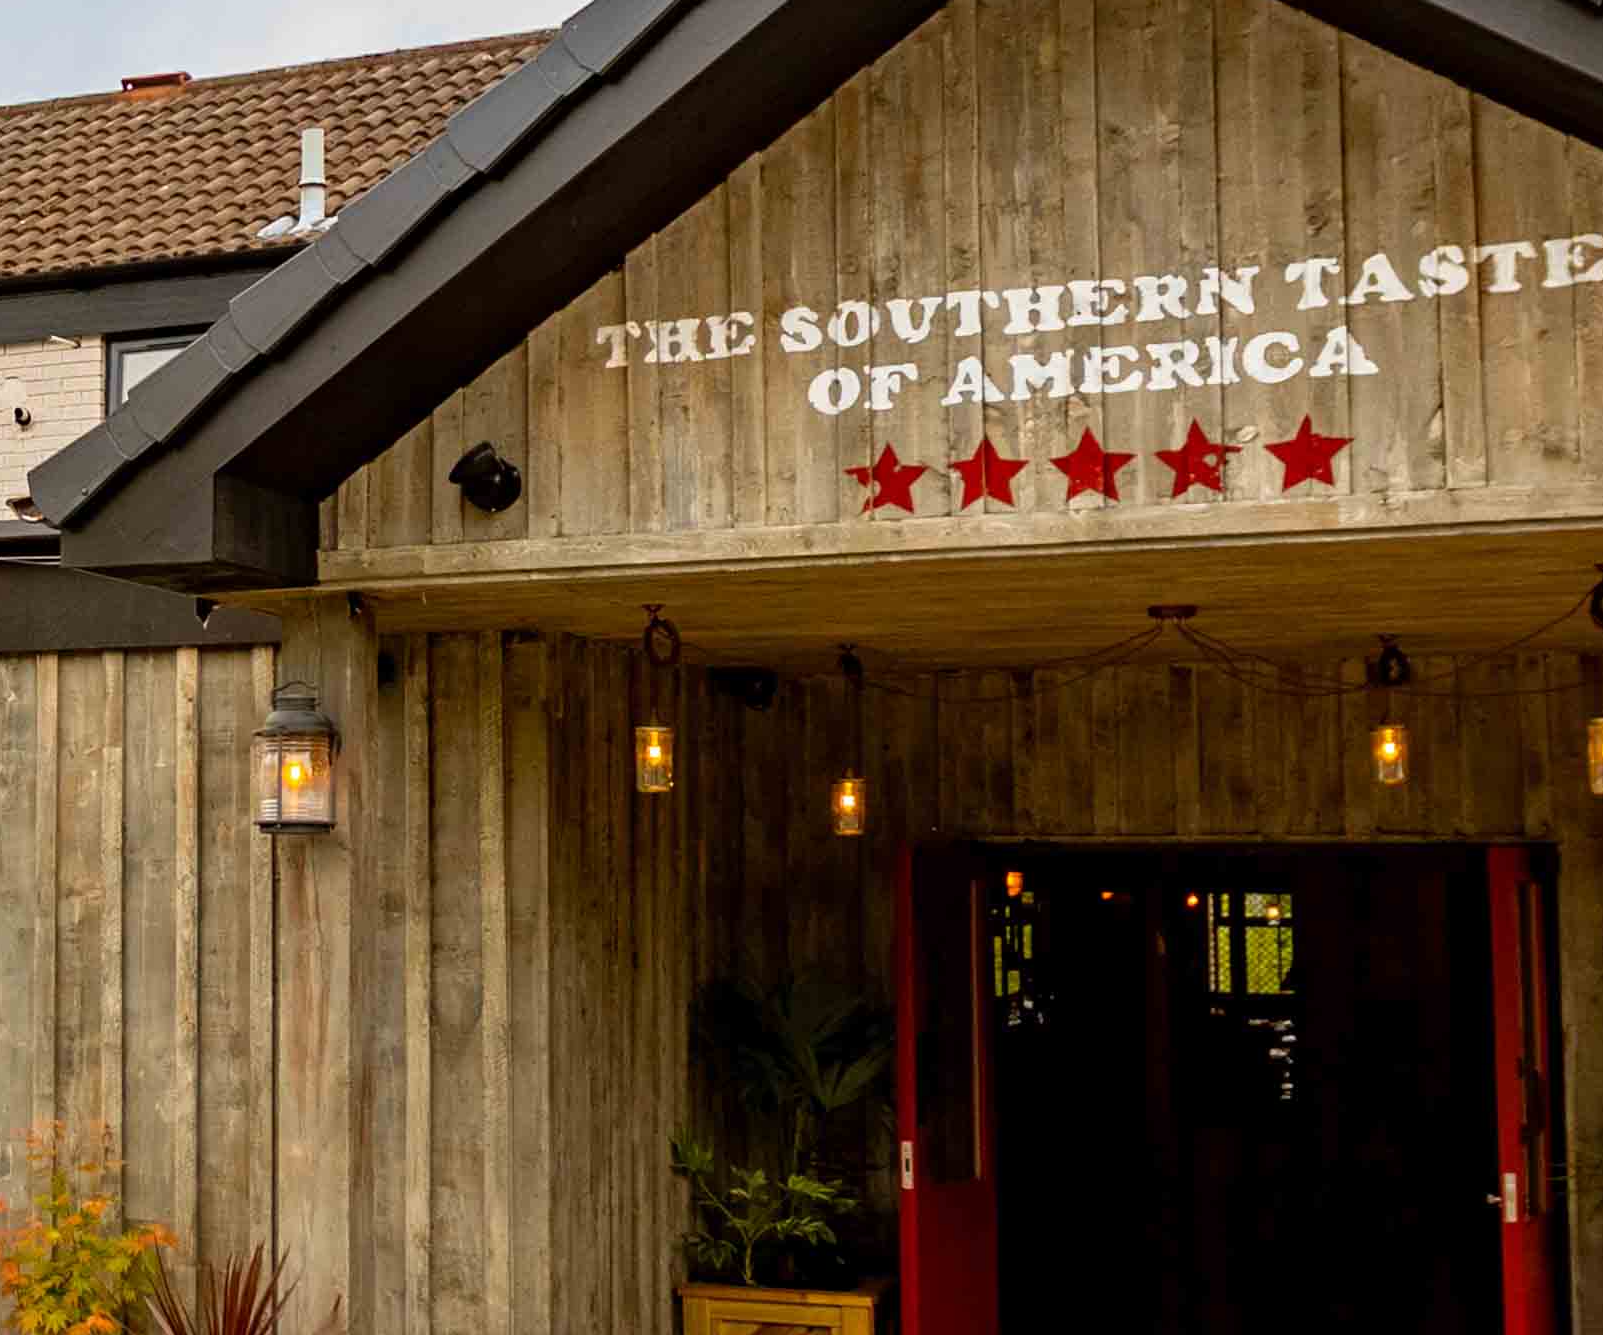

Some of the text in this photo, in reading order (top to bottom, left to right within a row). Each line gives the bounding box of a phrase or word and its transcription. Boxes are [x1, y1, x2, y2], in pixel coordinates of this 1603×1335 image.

[595, 310, 756, 370] THE
[779, 264, 1261, 355] SOUTHERN
[807, 324, 1380, 416] OF AMERICA
